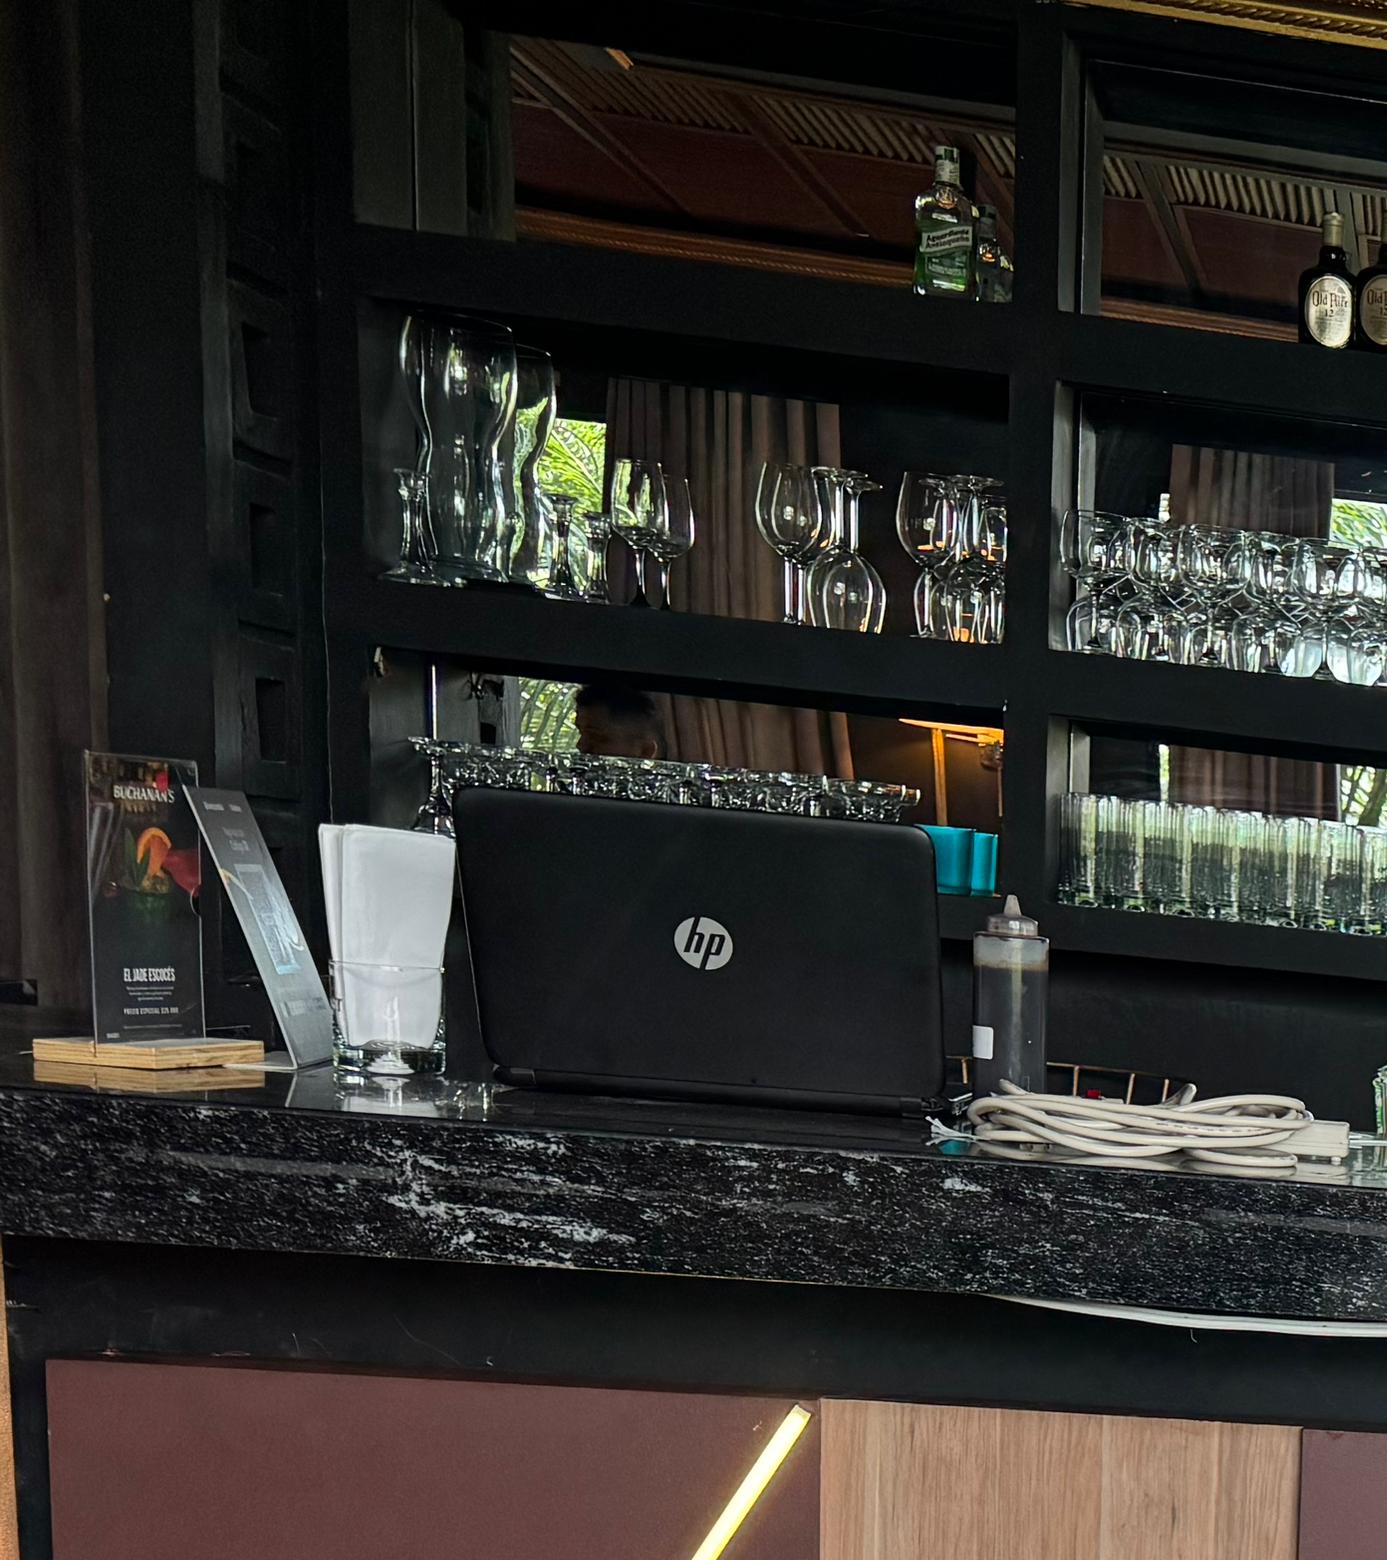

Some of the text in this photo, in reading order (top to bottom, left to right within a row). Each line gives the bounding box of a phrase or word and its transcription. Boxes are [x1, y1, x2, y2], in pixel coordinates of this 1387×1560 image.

[1312, 290, 1348, 308] Old Parr
[1366, 289, 1382, 306] Old
[1325, 309, 1334, 318] 12
[1380, 308, 1387, 316] 12
[684, 916, 726, 970] hp
